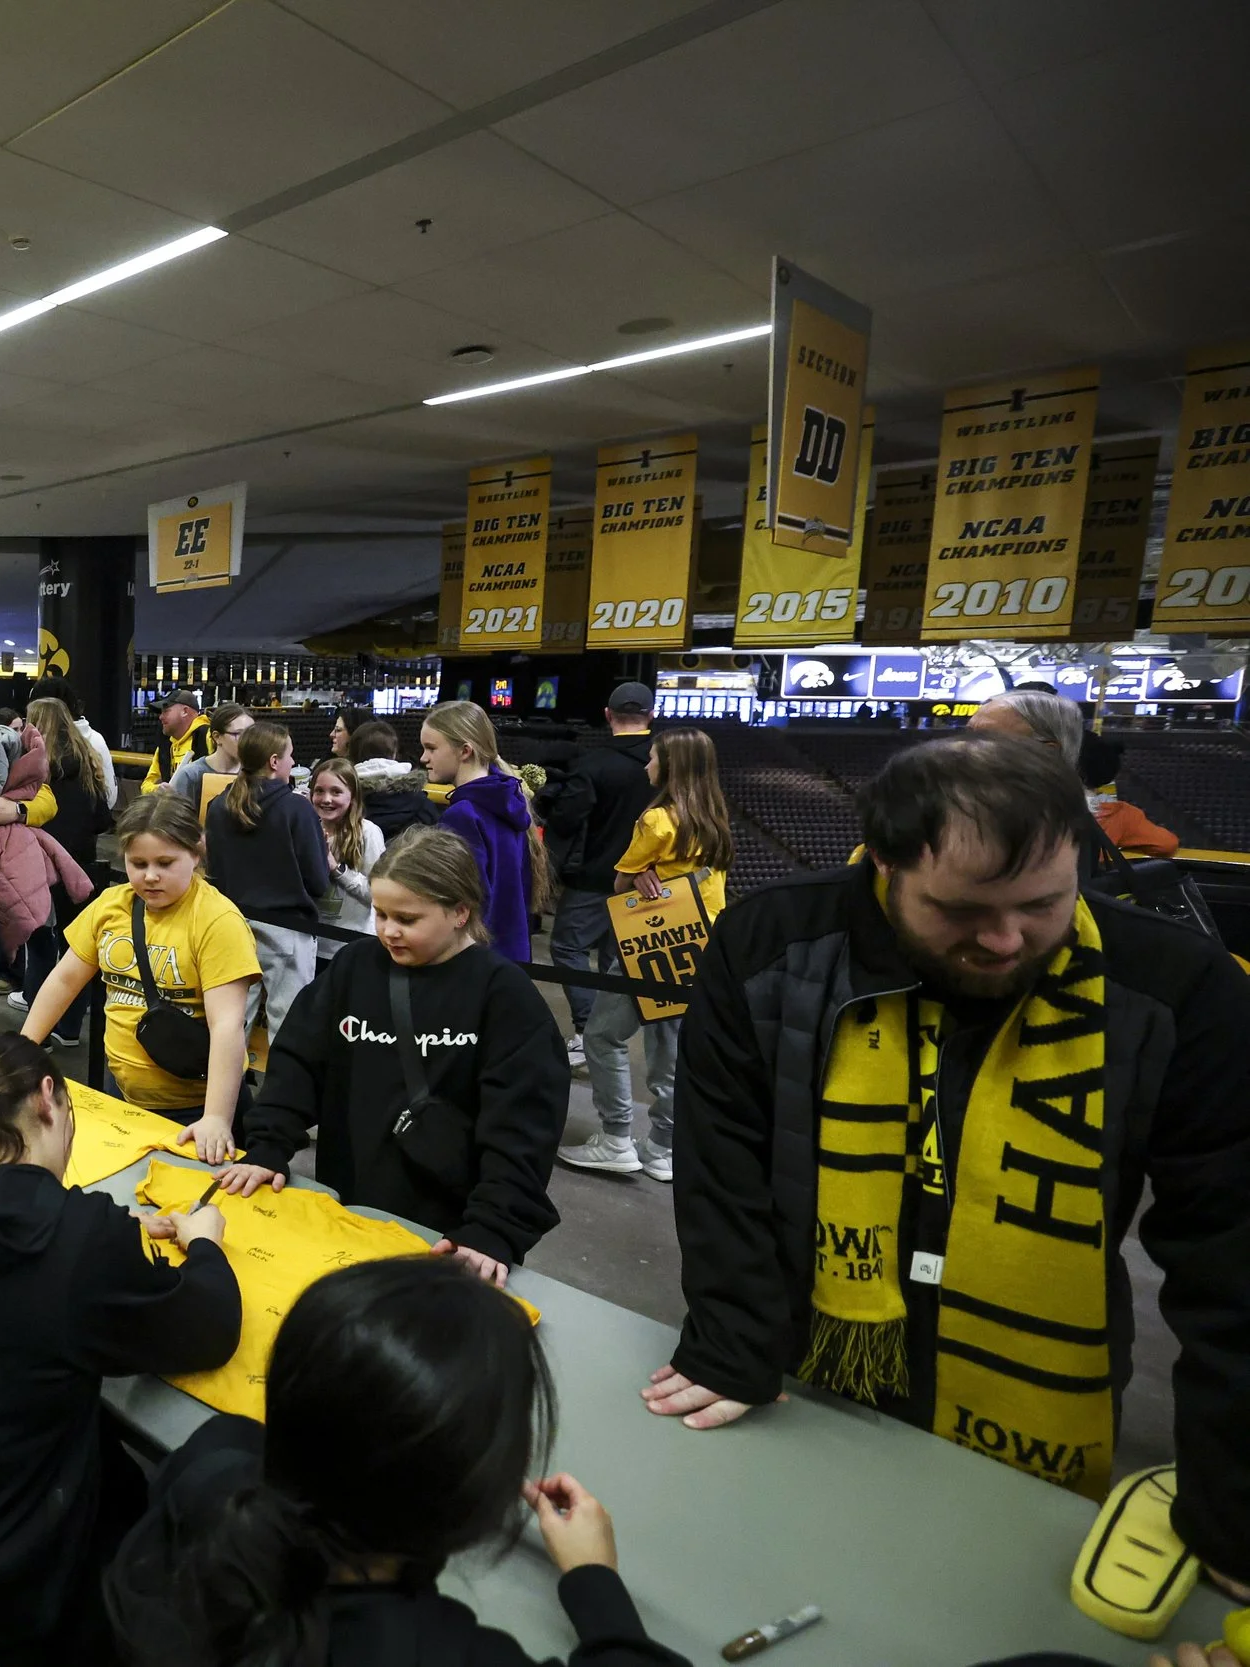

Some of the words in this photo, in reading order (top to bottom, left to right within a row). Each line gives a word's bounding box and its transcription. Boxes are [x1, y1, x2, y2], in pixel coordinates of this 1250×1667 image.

[797, 344, 857, 387] SECTION
[956, 411, 1076, 438] WRESTLING
[793, 405, 847, 486] DD
[947, 455, 998, 479] BIG
[1010, 445, 1080, 471] TEN
[607, 469, 683, 487] WRESTLING
[945, 469, 1076, 495] CHAMPIONS
[473, 519, 499, 533] BIG
[506, 513, 542, 529] TEN
[602, 502, 635, 519] BIG
[642, 496, 685, 514] TEN
[174, 517, 211, 557] EE
[472, 530, 541, 547] CHAMPIONS
[601, 515, 685, 534] CHAMPIONS
[958, 516, 1046, 540] NCAA
[938, 538, 1069, 560] CHAMPIONS
[469, 578, 538, 593] CHAMPIONS
[481, 562, 526, 578] NCAA
[928, 576, 1070, 618] 2010
[1157, 564, 1250, 609] 20
[463, 604, 540, 635] 2021
[589, 597, 686, 630] 2020
[740, 587, 854, 623] 2015
[620, 921, 706, 957] HAWKS
[339, 1015, 479, 1057] Chapion
[954, 1404, 1086, 1474] IOWA
